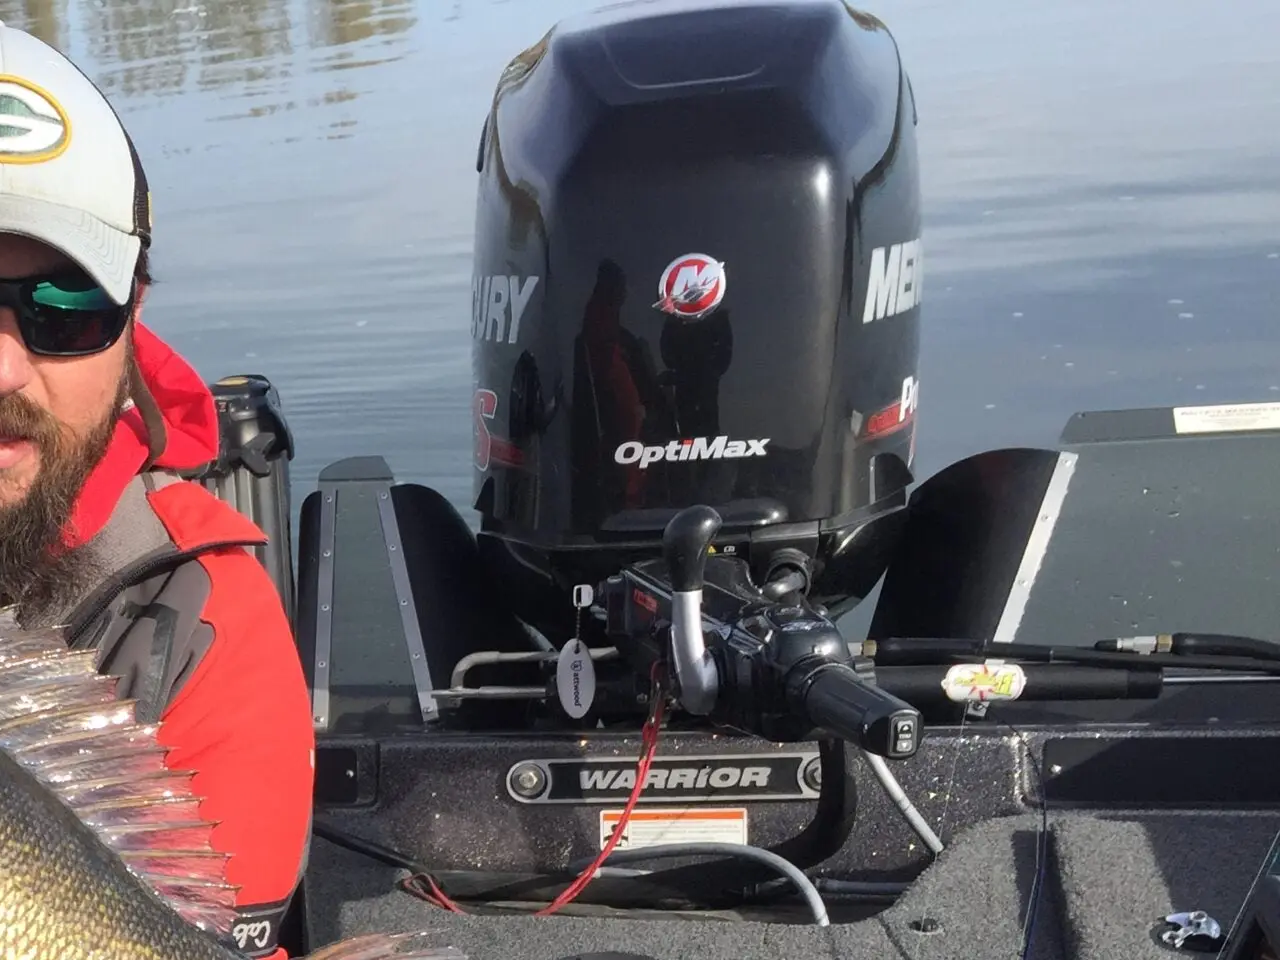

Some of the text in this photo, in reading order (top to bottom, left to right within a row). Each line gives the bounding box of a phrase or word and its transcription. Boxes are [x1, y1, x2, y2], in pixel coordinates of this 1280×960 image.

[614, 435, 771, 469] OptiMax
[572, 671, 583, 709] attwood
[579, 766, 772, 790] WARRIOR
